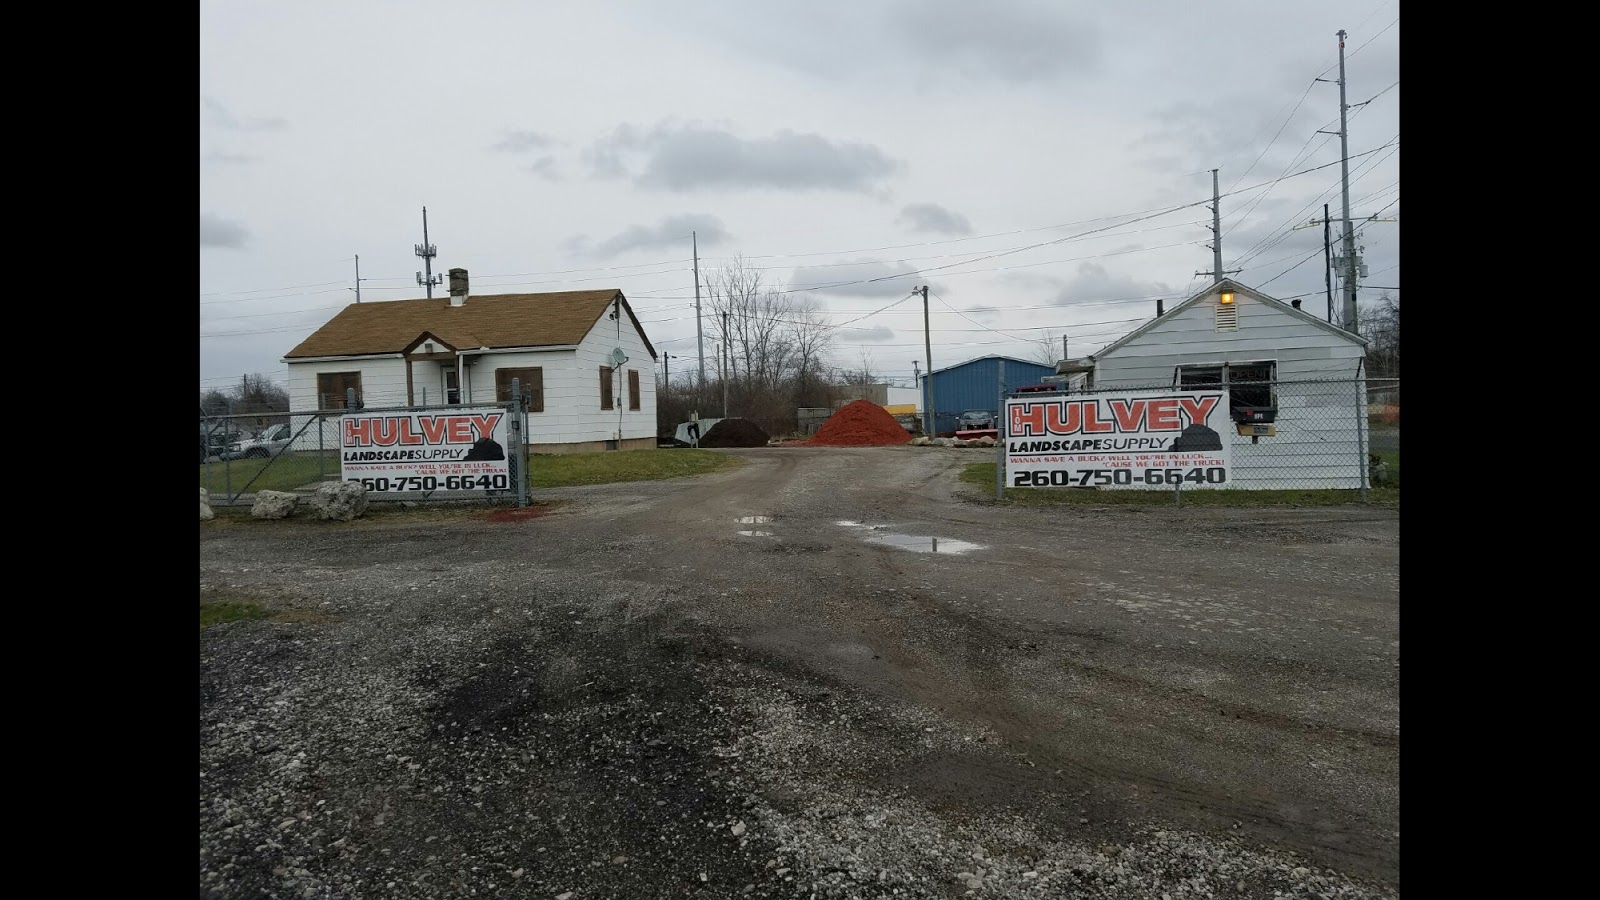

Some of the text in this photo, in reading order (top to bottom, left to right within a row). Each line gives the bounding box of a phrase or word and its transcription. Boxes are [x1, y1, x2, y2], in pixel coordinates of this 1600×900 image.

[343, 413, 504, 447] HULVEY
[1009, 395, 1223, 437] HULVEY
[1014, 408, 1022, 432] TOM
[1014, 468, 1226, 487] 260-750-6640
